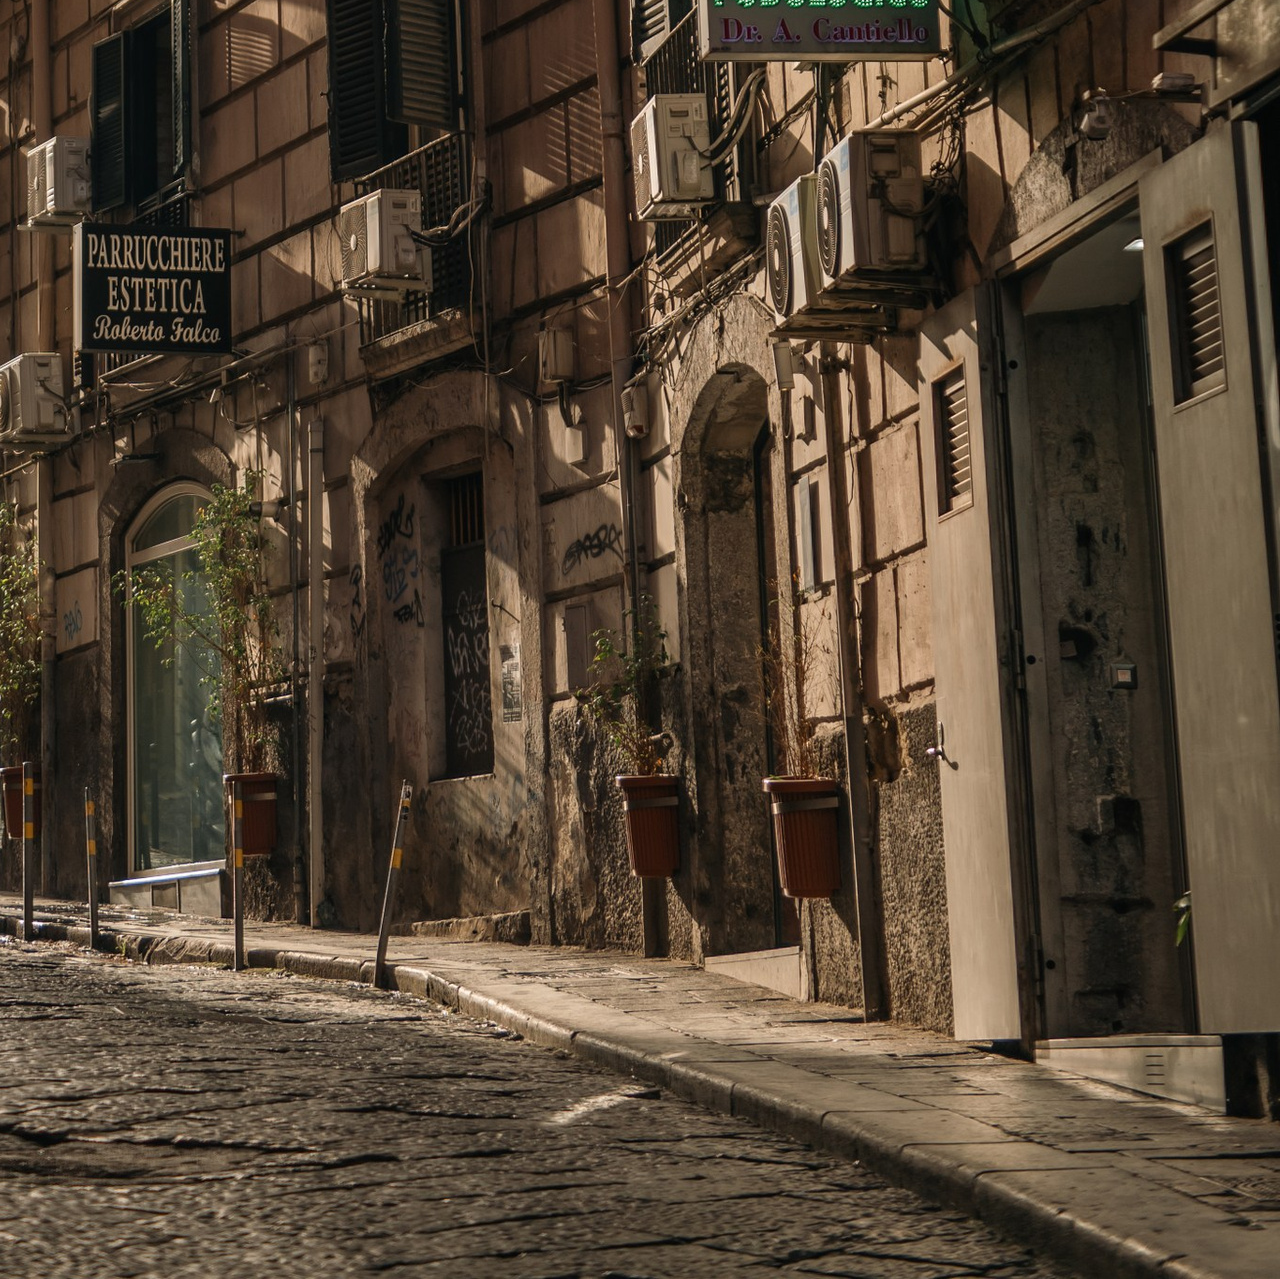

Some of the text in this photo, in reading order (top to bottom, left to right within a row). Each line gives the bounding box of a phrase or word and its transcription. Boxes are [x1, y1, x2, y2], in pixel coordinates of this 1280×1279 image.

[721, 17, 930, 43] Dr. A. Cantiello
[87, 233, 226, 272] PARRUCCHIERE
[107, 275, 207, 314] ESTETICA
[93, 314, 222, 343] Roberto Falco
